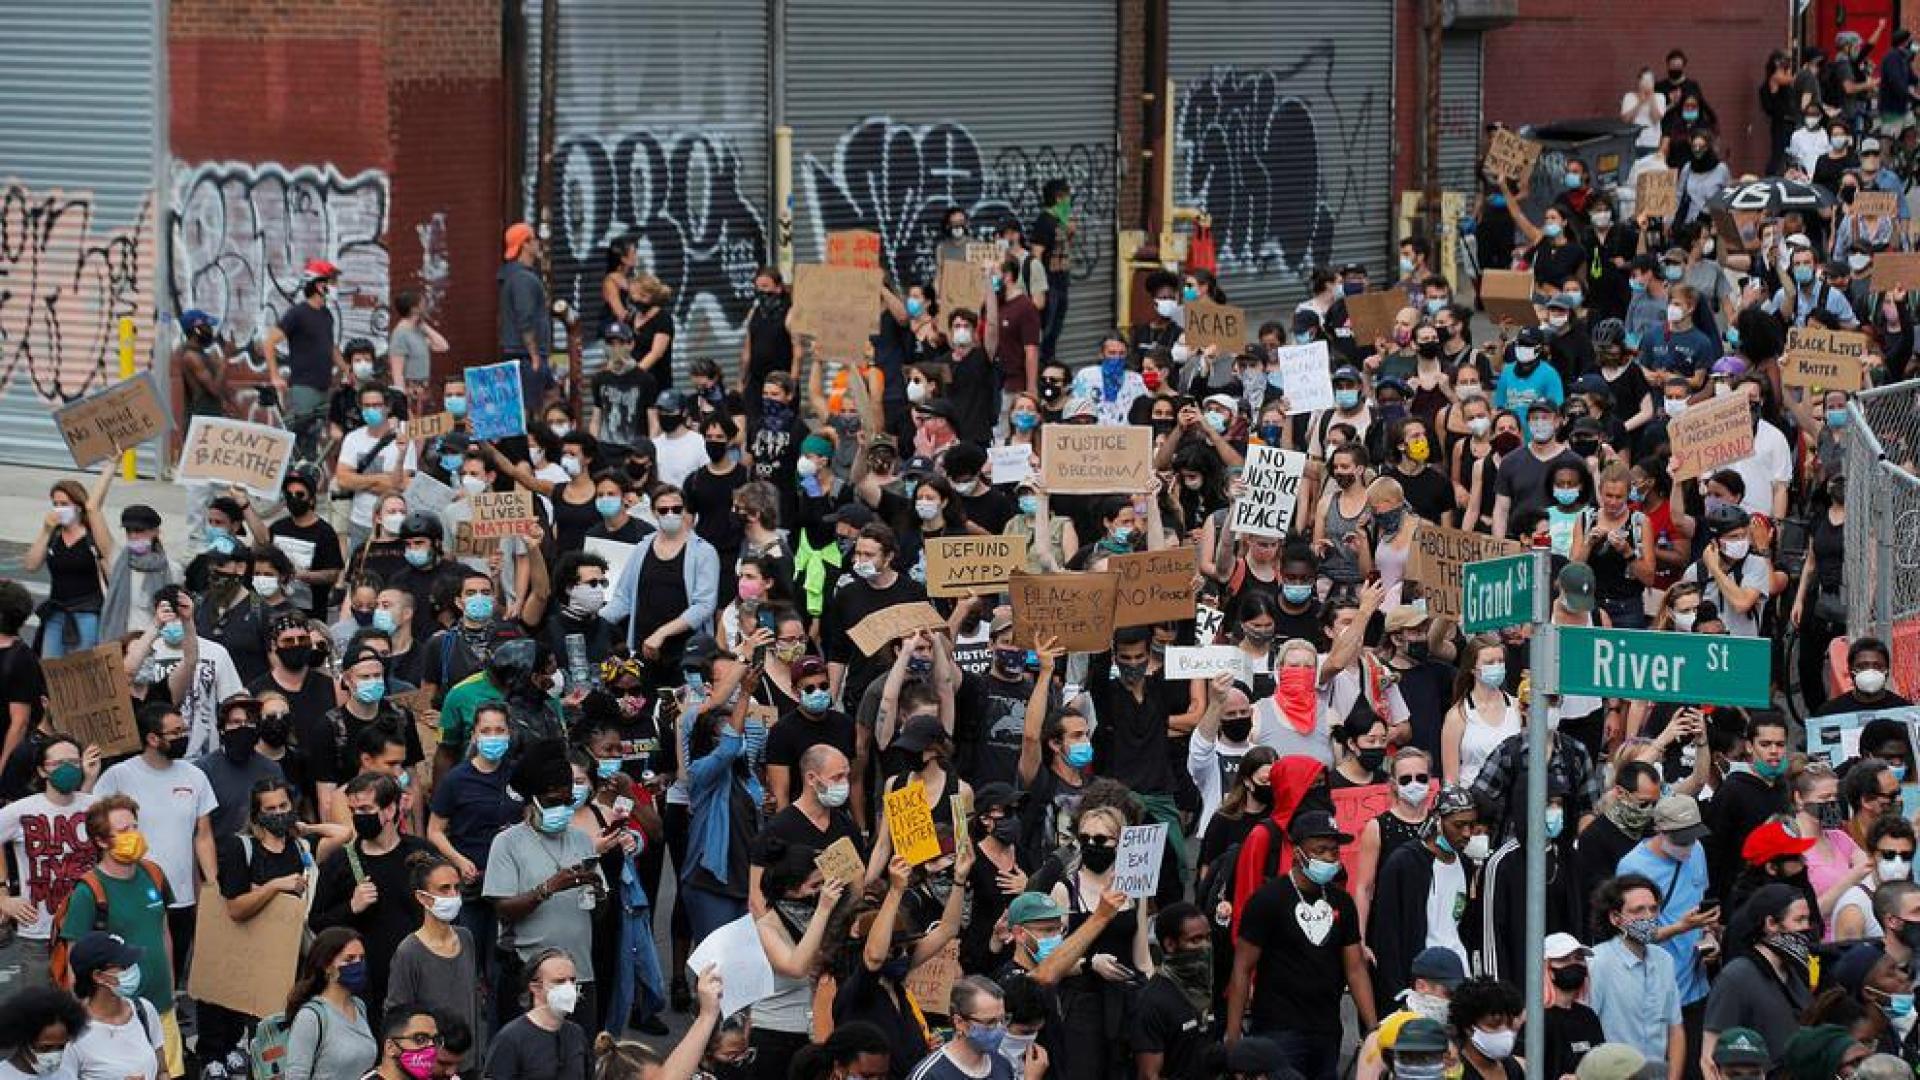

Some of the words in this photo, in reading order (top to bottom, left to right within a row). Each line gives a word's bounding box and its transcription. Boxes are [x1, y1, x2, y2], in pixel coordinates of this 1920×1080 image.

[1188, 310, 1237, 338] ACAB
[198, 424, 213, 444] I
[221, 428, 279, 453] CAN'T
[1056, 434, 1127, 451] JUSTICE
[195, 447, 281, 479] BREATHE
[1258, 448, 1285, 468] NO
[1246, 464, 1300, 496] JUSTICE
[474, 493, 525, 507] BLACK
[1252, 489, 1277, 506] NO
[480, 506, 526, 520] LIVES
[1236, 502, 1288, 533] PEACE
[941, 541, 1010, 560] DEFUND
[948, 562, 1004, 581] NYPD
[1023, 585, 1081, 606] BLACK
[1118, 588, 1145, 607] NO
[1466, 566, 1512, 623] Grand
[1517, 561, 1528, 591] St
[1593, 638, 1686, 692] River
[1706, 643, 1730, 673] St
[888, 790, 922, 817] BLACK
[20, 812, 94, 858] BLAC
[1122, 825, 1162, 848] SHUT
[1114, 873, 1154, 892] DOWN
